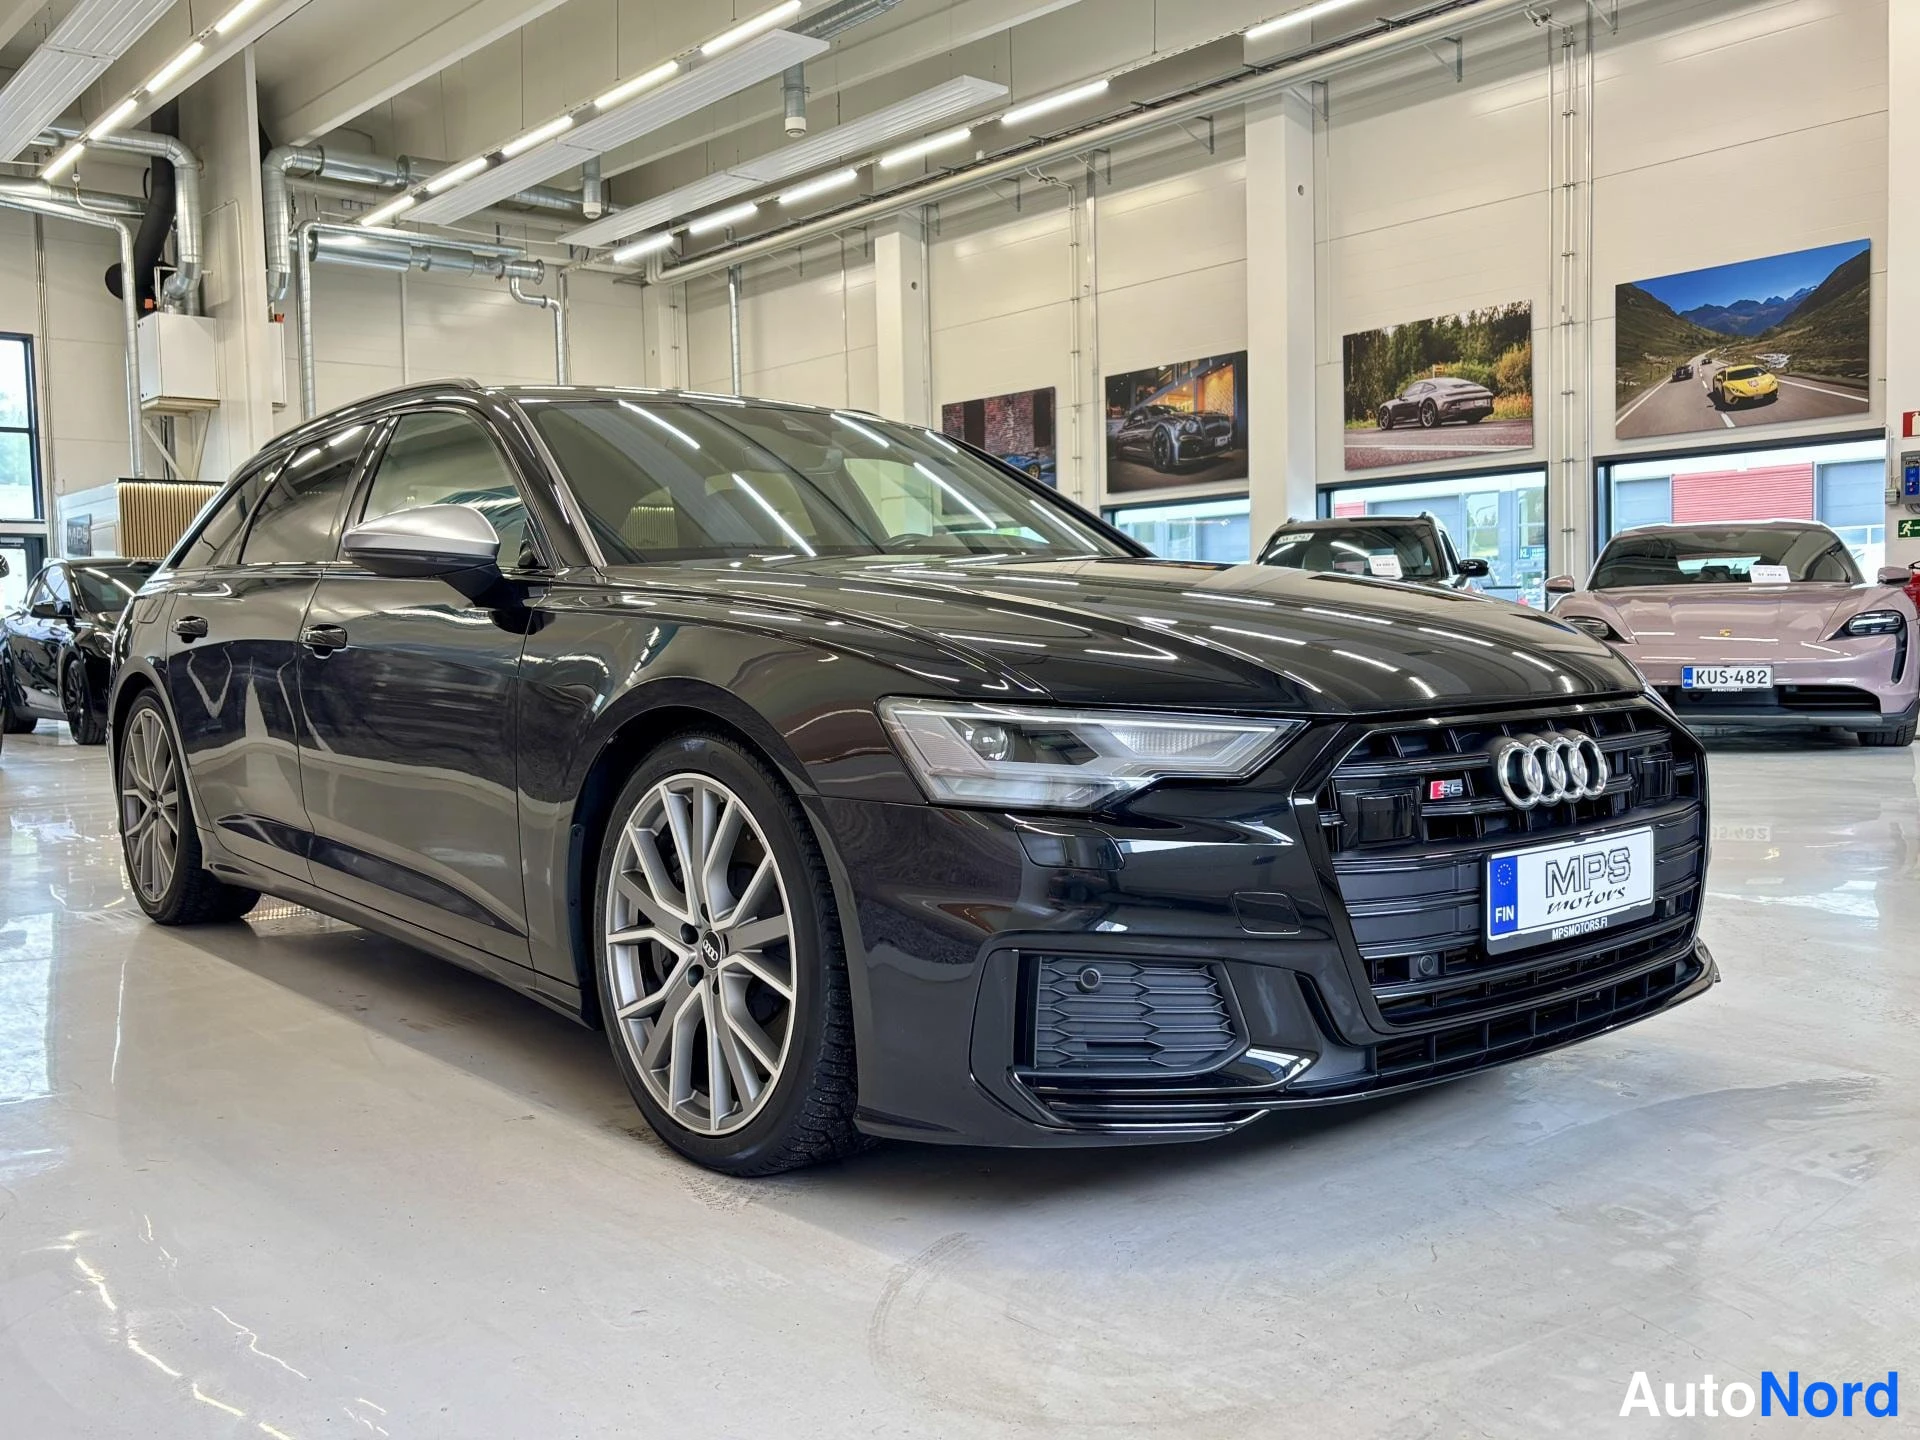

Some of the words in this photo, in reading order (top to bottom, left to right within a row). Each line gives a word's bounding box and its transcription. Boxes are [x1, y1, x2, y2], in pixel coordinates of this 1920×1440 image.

[68, 526, 89, 546] MPS
[1696, 670, 1767, 684] KUS-482
[1438, 784, 1463, 796] S6
[1546, 847, 1631, 898] MPS
[1547, 887, 1626, 915] motors
[1496, 905, 1514, 923] FIN
[1552, 916, 1608, 941] MPSMOTORS.FI
